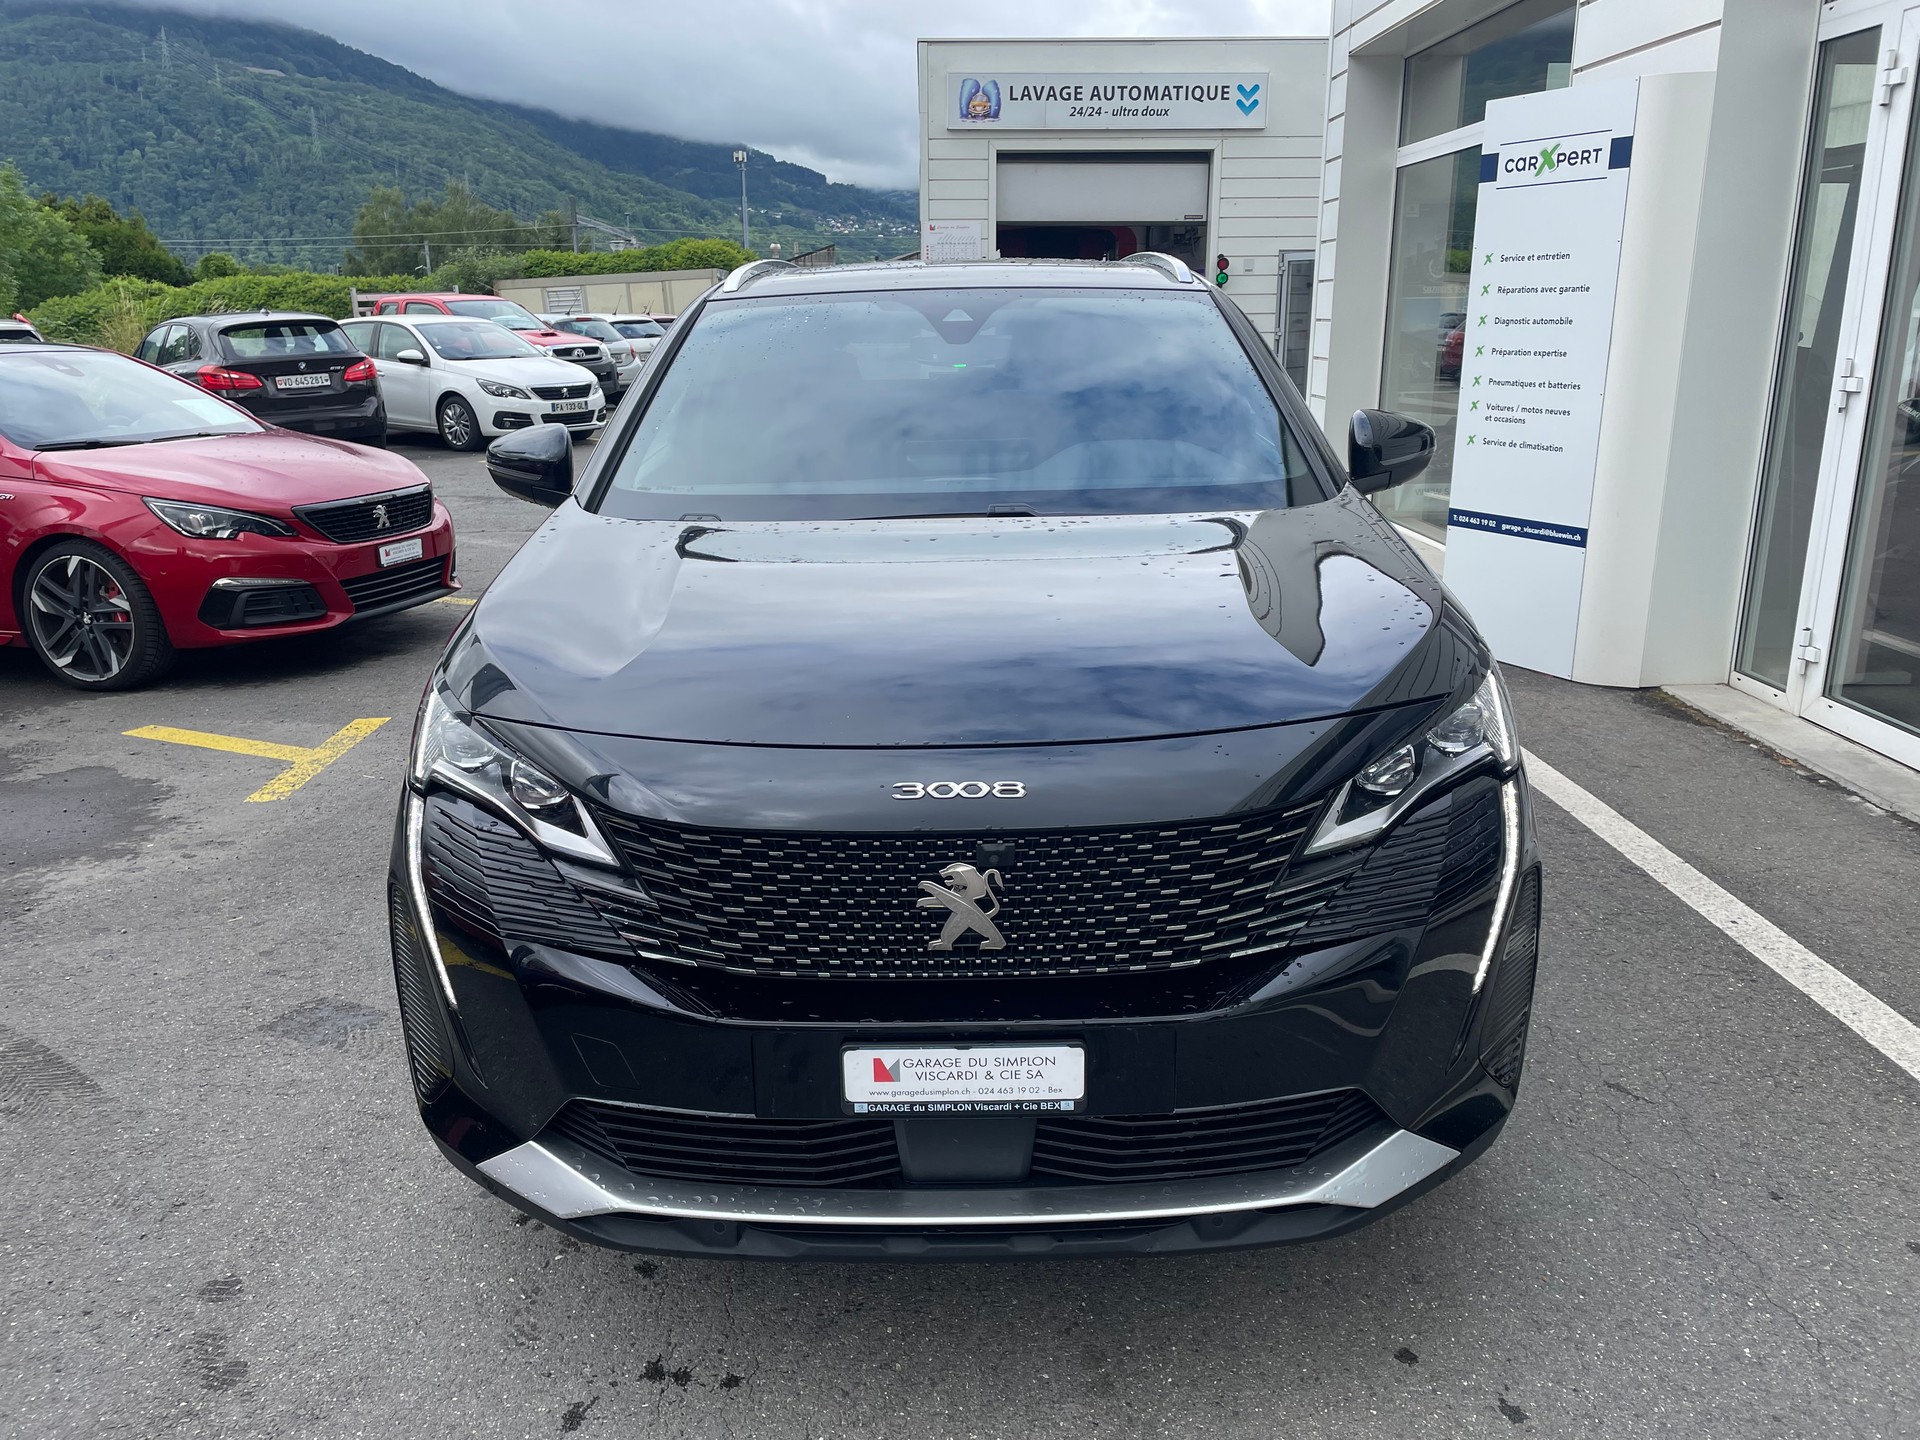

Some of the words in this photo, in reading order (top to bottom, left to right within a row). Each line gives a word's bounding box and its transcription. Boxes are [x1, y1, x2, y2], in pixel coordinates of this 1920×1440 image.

[1009, 85, 1084, 101] LAVAGE
[1089, 84, 1231, 102] AUTOMATIQUE
[1069, 106, 1102, 117] 24/24
[1112, 106, 1139, 117] ultra
[1141, 106, 1170, 117] doux
[1500, 254, 1526, 263] Service
[1527, 254, 1535, 262] et
[1537, 252, 1571, 261] entretien
[1497, 284, 1539, 295] Réparations
[1540, 286, 1557, 294] avec
[1559, 284, 1591, 295] garantie
[1494, 316, 1531, 327] Diagnostic
[1532, 316, 1573, 326] automobile
[1491, 347, 1532, 359] Préparation
[1533, 349, 1568, 359] expertise
[1488, 378, 1537, 390] Pneumatiques
[1538, 380, 1546, 389] et
[1548, 380, 1581, 391] batteries
[1486, 403, 1515, 413] Voitures
[1521, 405, 1543, 415] motos
[1545, 408, 1571, 417] neuves
[1484, 414, 1493, 423] et
[1494, 415, 1526, 425] occasions
[1482, 437, 1507, 448] Service
[1508, 439, 1518, 449] de
[1519, 440, 1563, 453] climatisation
[1453, 514, 1459, 522] T:
[1458, 515, 1469, 523] 024
[1470, 516, 1480, 525] 463
[1481, 518, 1488, 526] 19
[1488, 519, 1496, 528] 02
[1501, 523, 1582, 541] garage_viscardi@bluewin.ch
[891, 781, 1027, 800] 3008
[902, 1057, 962, 1069] GARAGE
[968, 1056, 988, 1068] DU
[994, 1056, 1056, 1068] SIMPLON
[915, 1069, 978, 1081] VISCARDI
[984, 1069, 994, 1081] &
[999, 1069, 1021, 1080] CIE
[1026, 1068, 1044, 1080] SA
[869, 1087, 971, 1098] www.garagedusimplon.ch
[978, 1087, 995, 1095] 024
[1017, 1086, 1027, 1094] 19
[1028, 1086, 1040, 1094] 02
[1048, 1086, 1063, 1094] Bex
[868, 1103, 911, 1112] GARAGE
[913, 1103, 925, 1112] du
[927, 1103, 972, 1112] SIMPLON
[974, 1102, 1012, 1111] Viscardi
[1022, 1102, 1038, 1111] Cie
[1040, 1101, 1060, 1110] BEX
